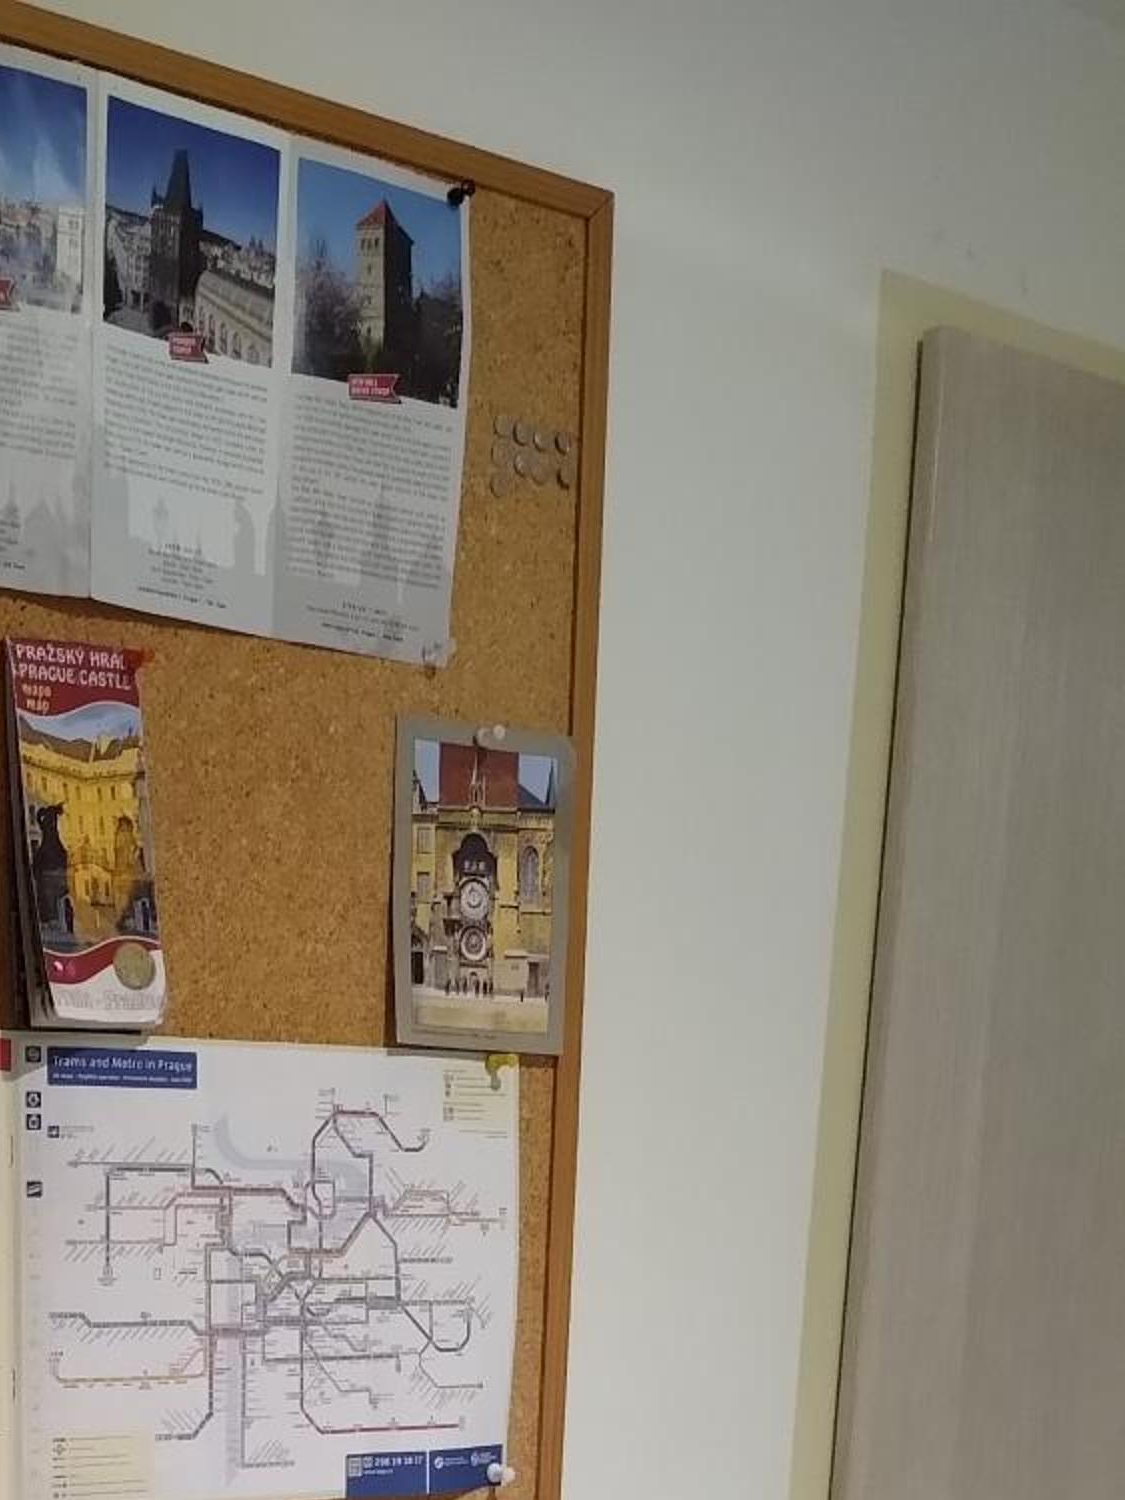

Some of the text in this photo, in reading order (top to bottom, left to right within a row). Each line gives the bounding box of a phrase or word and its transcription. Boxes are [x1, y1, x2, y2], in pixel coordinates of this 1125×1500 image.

[15, 642, 86, 665] PRAŽSKÝ
[18, 663, 76, 684] PRAGUE
[52, 1055, 193, 1073] Trams and Metro in Prague
